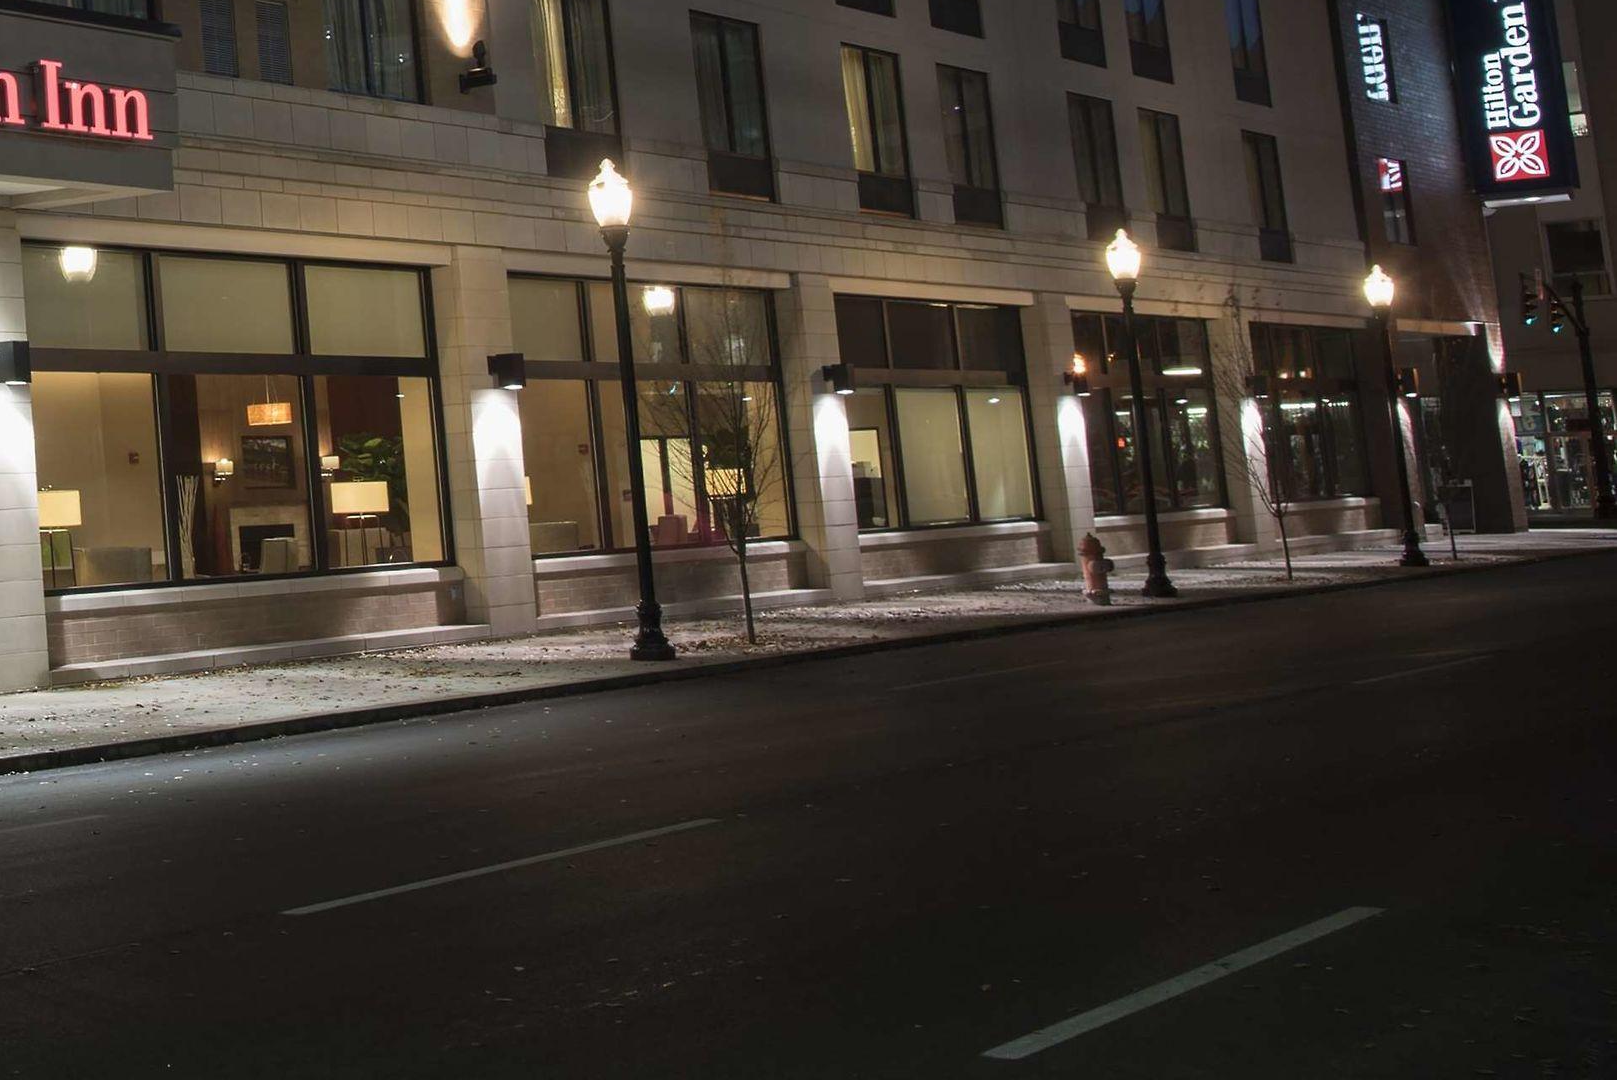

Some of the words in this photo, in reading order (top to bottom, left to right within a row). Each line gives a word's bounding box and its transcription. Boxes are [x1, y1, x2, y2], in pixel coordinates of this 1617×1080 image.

[39, 58, 154, 140] Inn
[1483, 51, 1510, 129] Hilton
[1500, 2, 1540, 128] Garden
